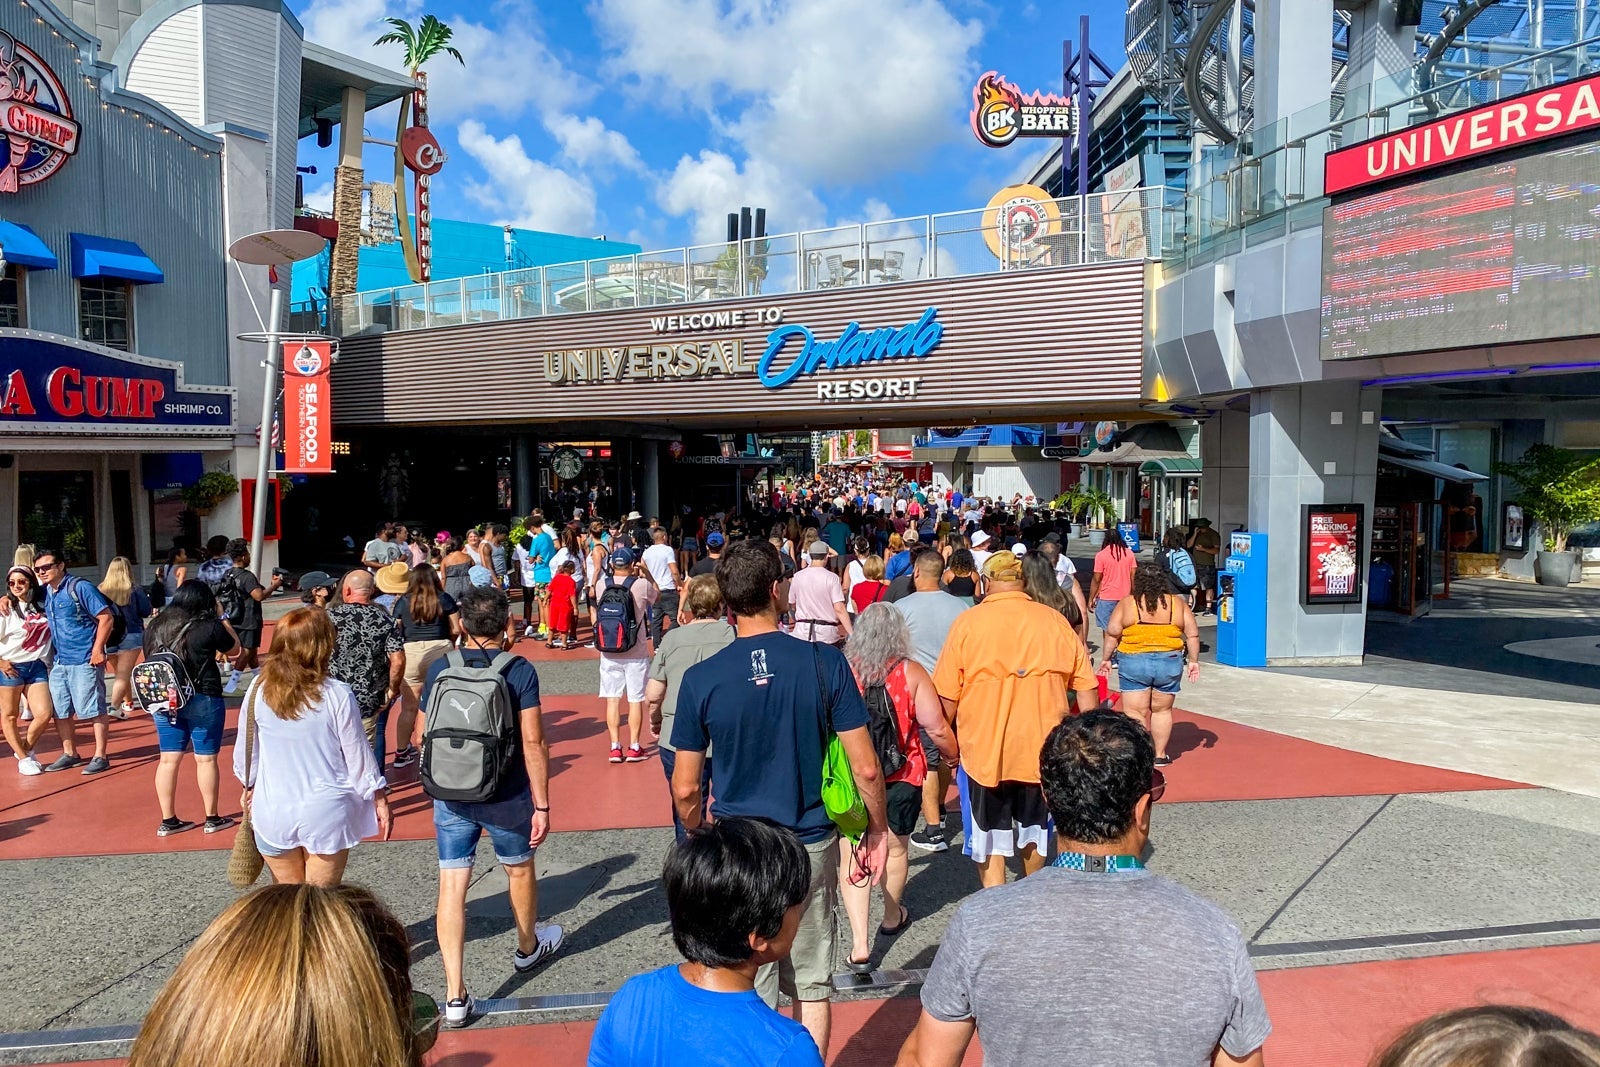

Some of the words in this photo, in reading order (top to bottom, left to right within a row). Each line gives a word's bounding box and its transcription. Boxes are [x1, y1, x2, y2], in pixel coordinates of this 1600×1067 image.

[987, 107, 1016, 132] BK
[1021, 106, 1069, 114] WHOPPER
[1021, 114, 1069, 130] BAR
[7, 104, 73, 148] GUMP
[1367, 83, 1600, 177] UNIVERSA
[29, 153, 61, 180] MARKET
[651, 309, 745, 332] WELCOME
[755, 306, 784, 324] TO
[543, 339, 757, 383] UNIVERSAL
[758, 306, 944, 389] Orlando
[0, 368, 36, 415] A
[46, 365, 165, 418] GUMP
[164, 403, 205, 414] SHRIMP
[206, 406, 223, 414] CO.
[817, 377, 921, 400] RESORT
[305, 383, 318, 463] SEAFOOD
[677, 455, 730, 463] ONCIERGE
[1312, 516, 1333, 524] FREE
[1312, 523, 1348, 531] PARKING
